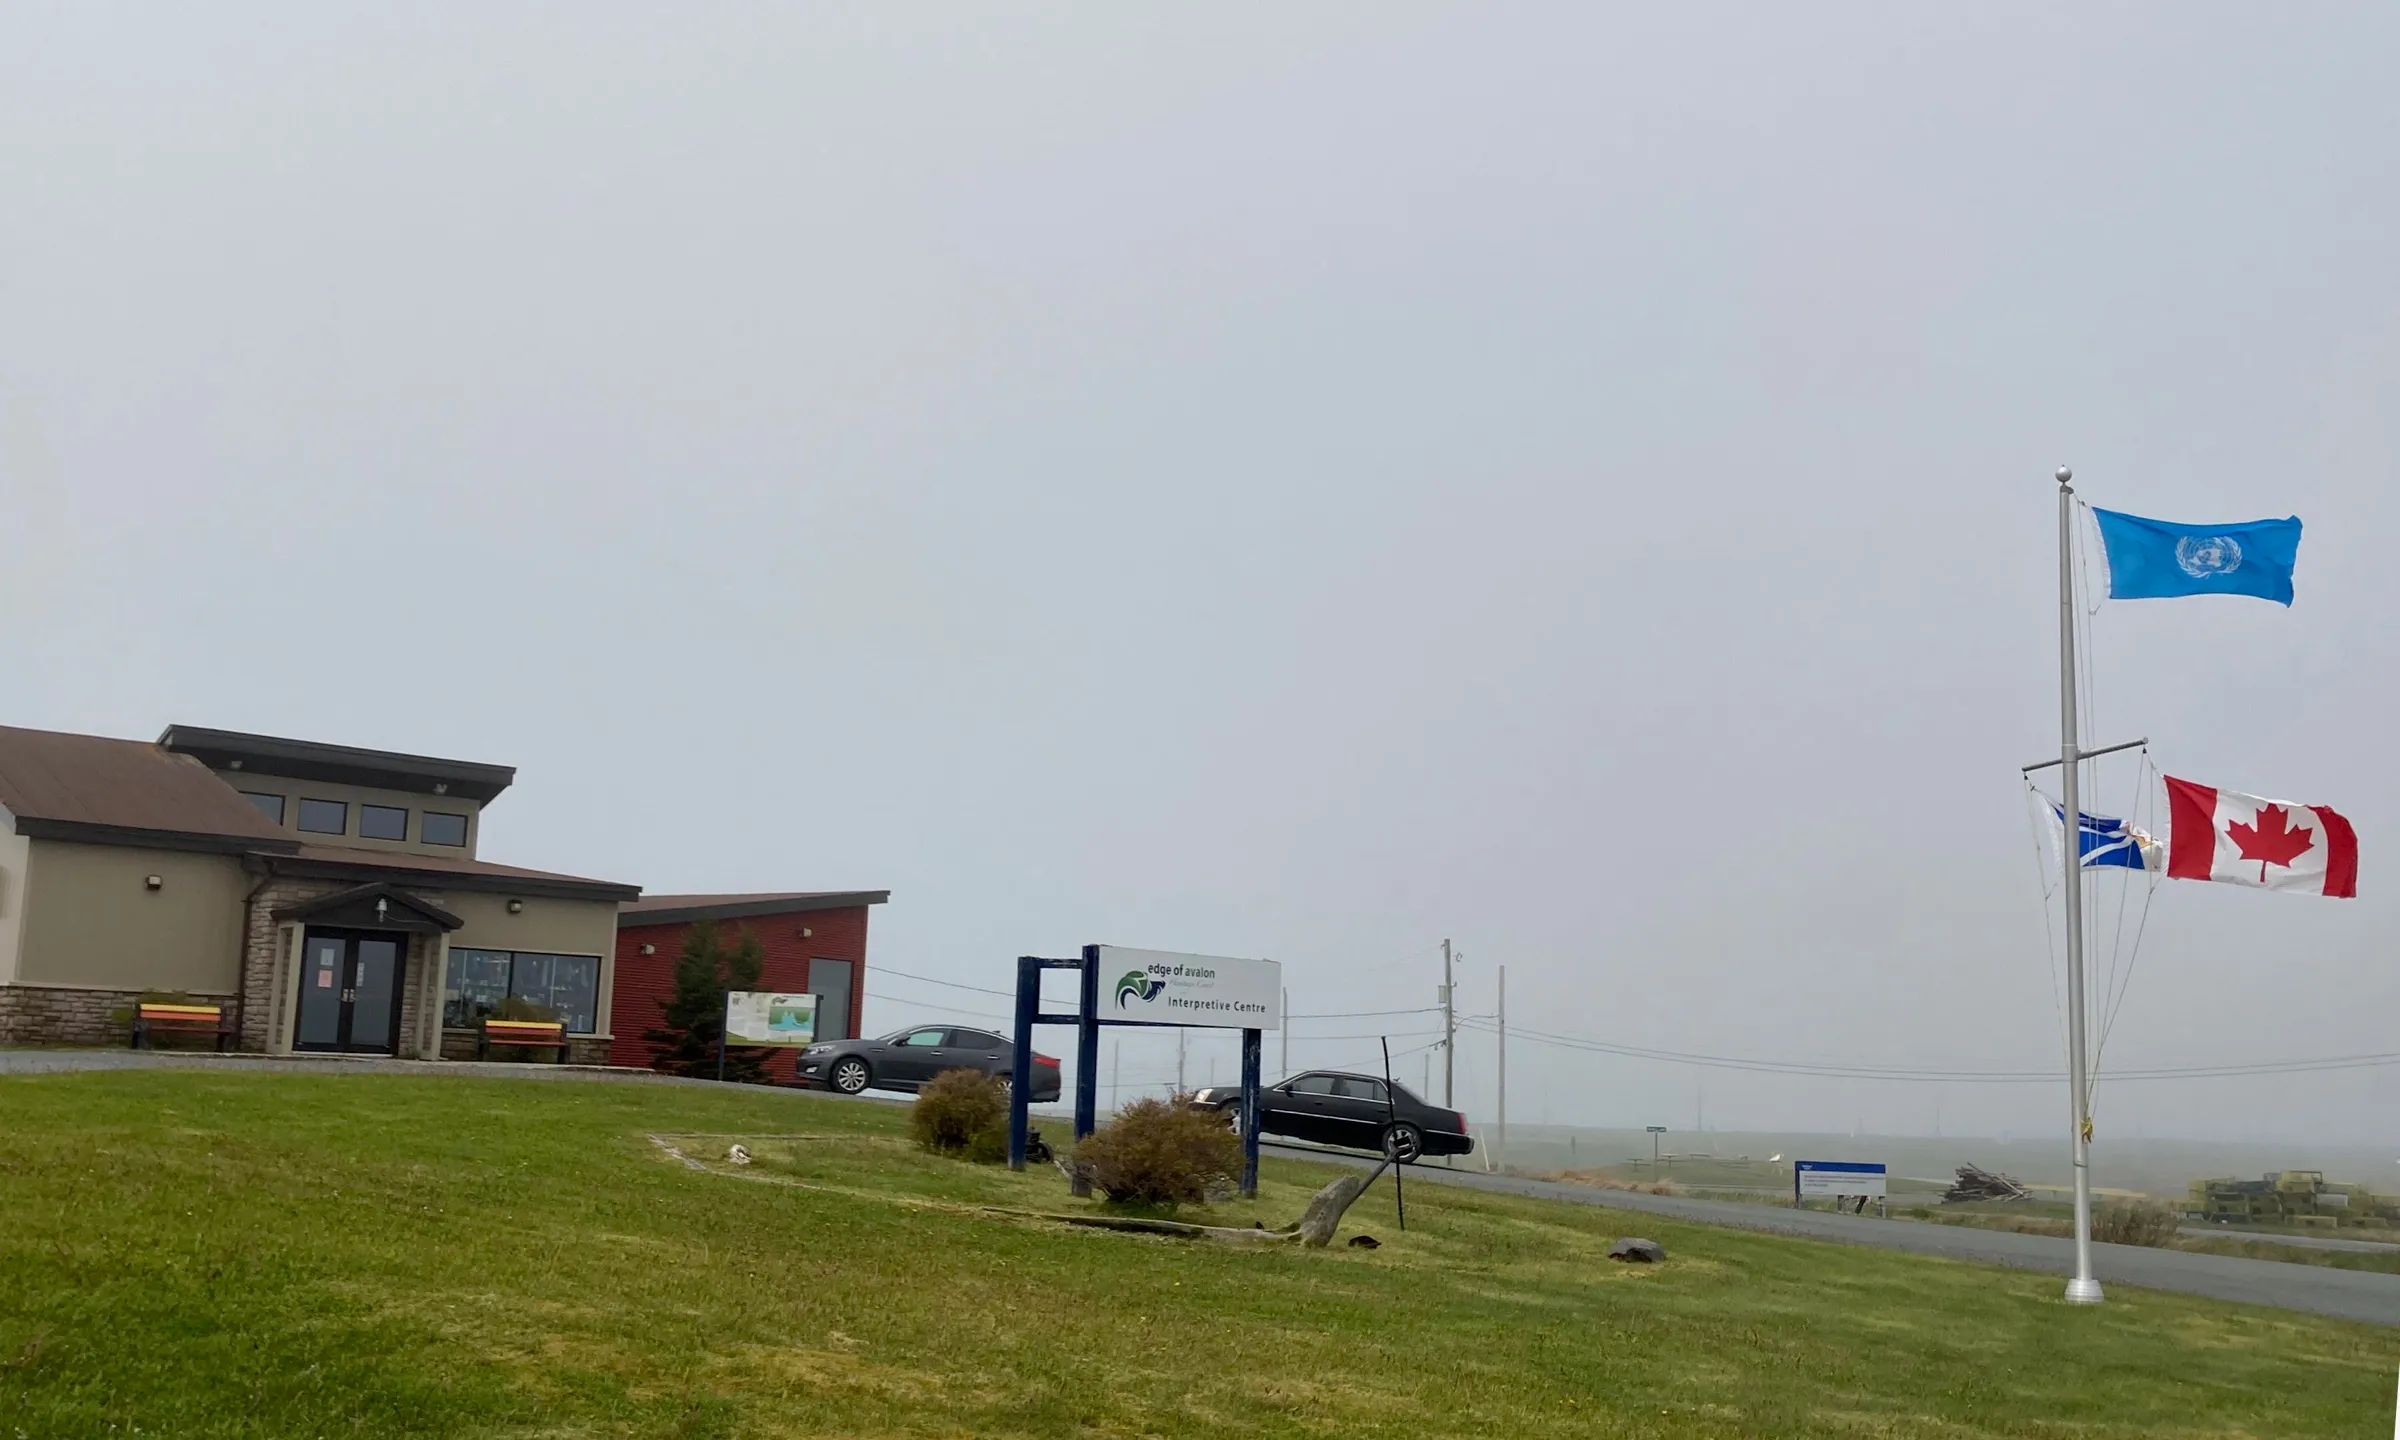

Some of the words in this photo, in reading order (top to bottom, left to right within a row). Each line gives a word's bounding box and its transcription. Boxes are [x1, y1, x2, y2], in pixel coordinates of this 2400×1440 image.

[1148, 963, 1172, 977] edge
[1173, 964, 1184, 976] of
[1185, 967, 1215, 979] avalon
[1168, 996, 1231, 1011] Interpretive
[1234, 1001, 1266, 1013] Centre
